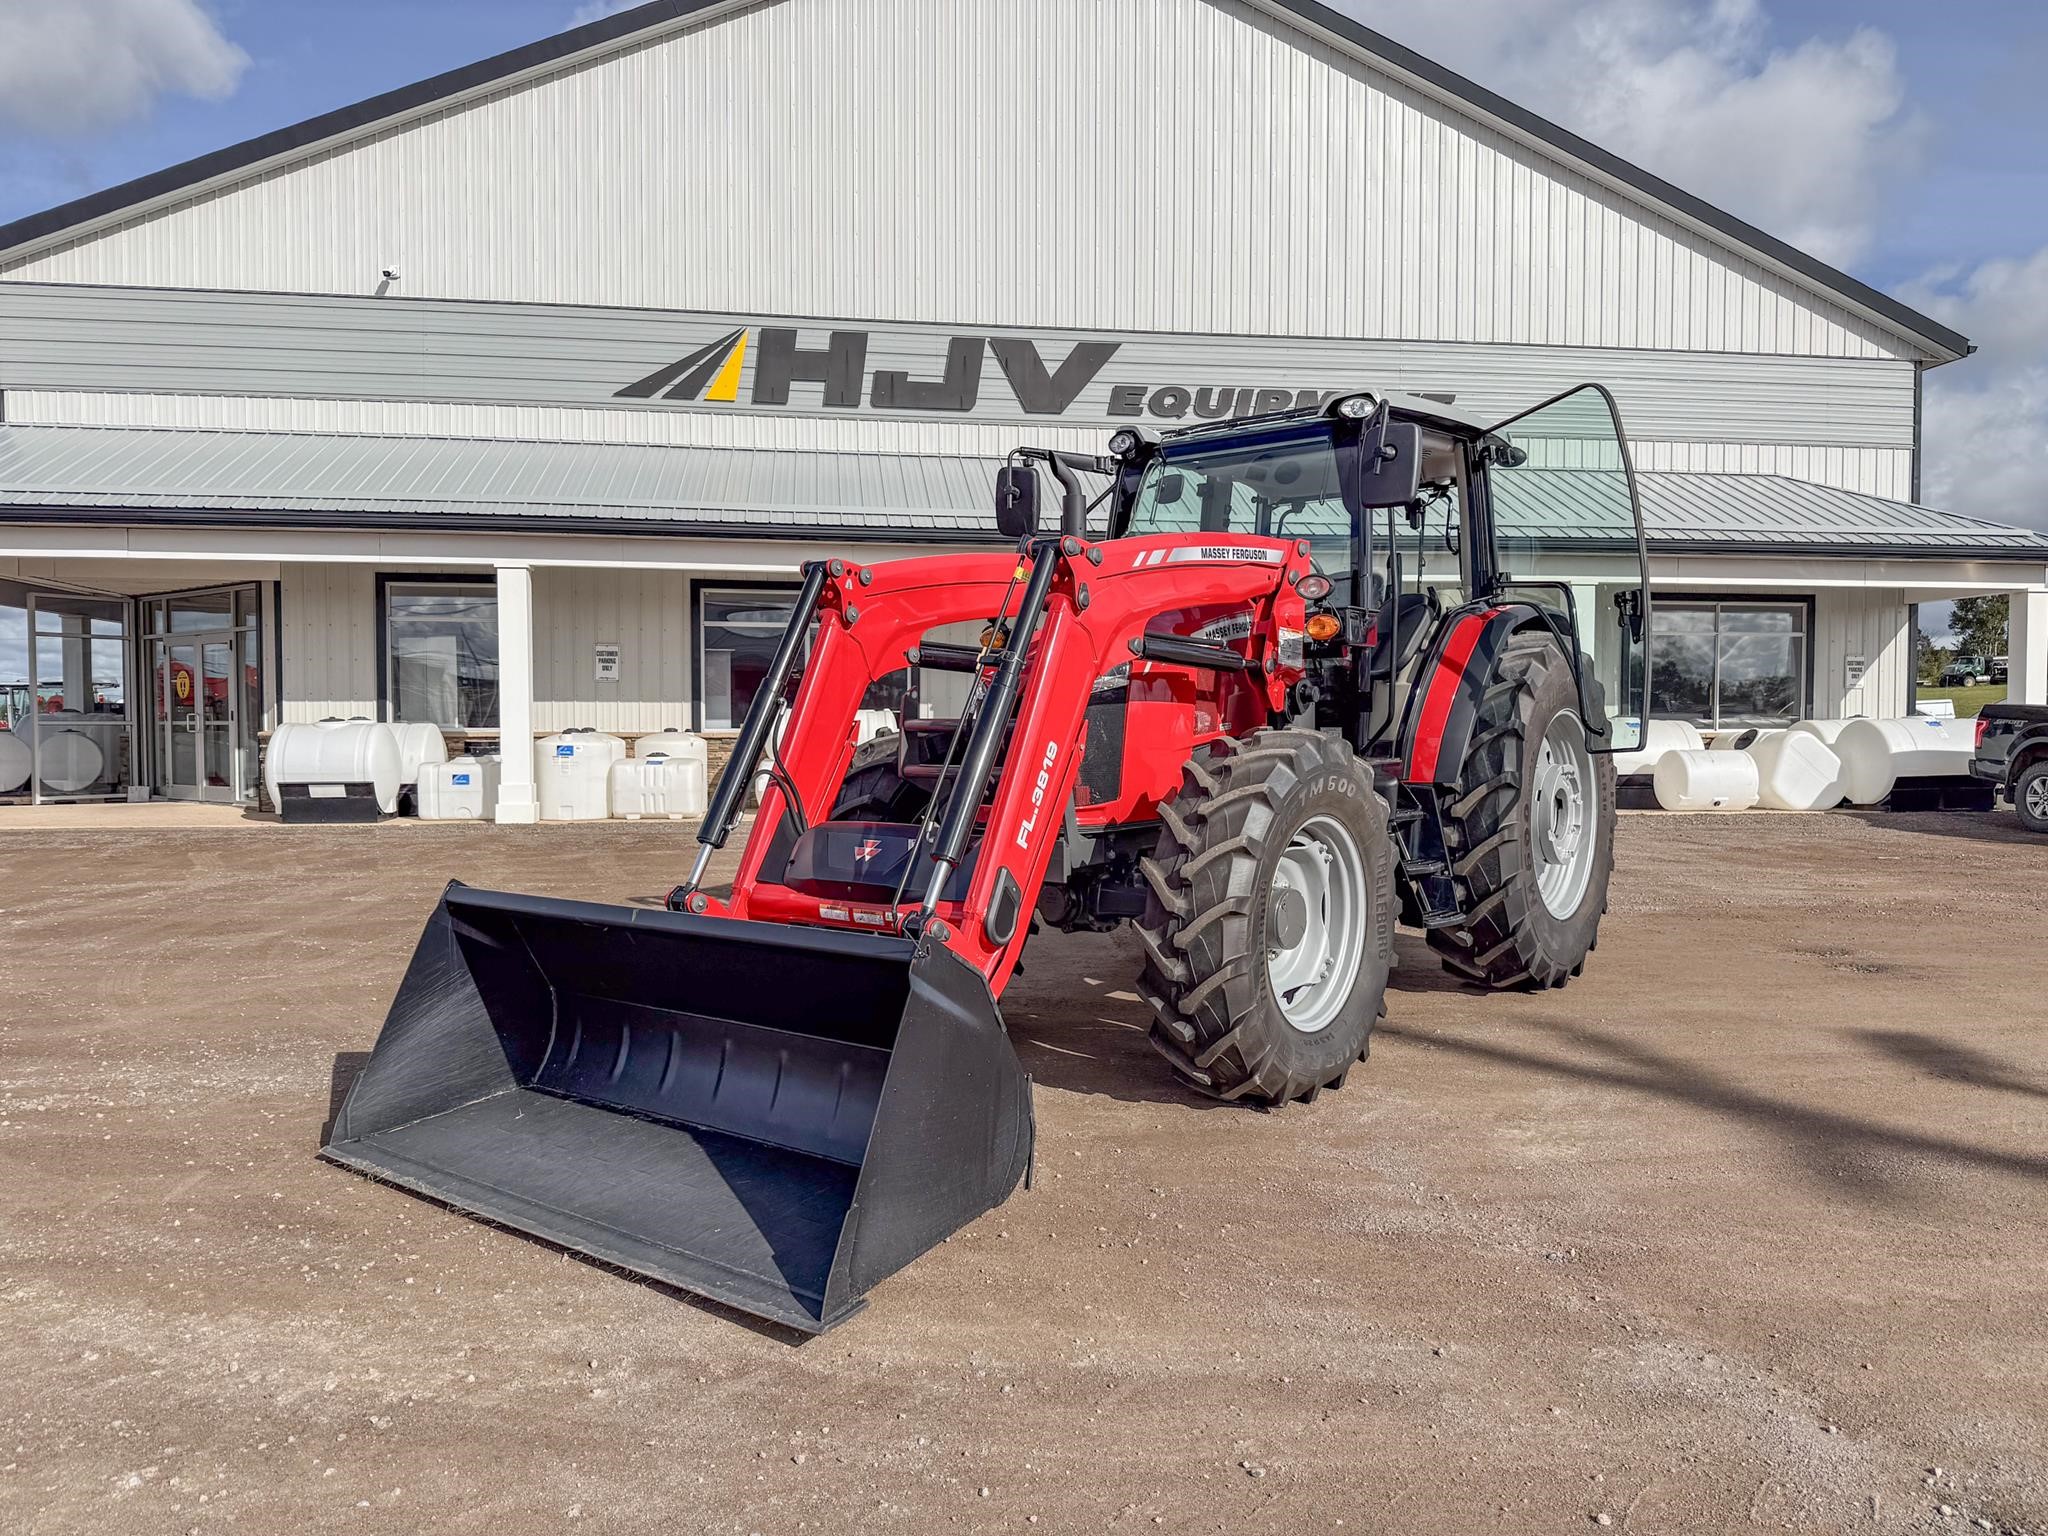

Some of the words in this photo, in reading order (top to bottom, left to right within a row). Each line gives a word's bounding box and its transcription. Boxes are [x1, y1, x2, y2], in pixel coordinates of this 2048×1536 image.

[752, 327, 1122, 415] HJV
[1200, 547, 1231, 559] MASSEY
[1232, 548, 1268, 561] FERGUSON
[1205, 624, 1231, 640] MASSEY
[598, 657, 617, 665] PARKING
[1993, 718, 2029, 728] SPORT
[1016, 740, 1058, 850] FL.3819
[1375, 850, 1389, 960] TRELLEBORG
